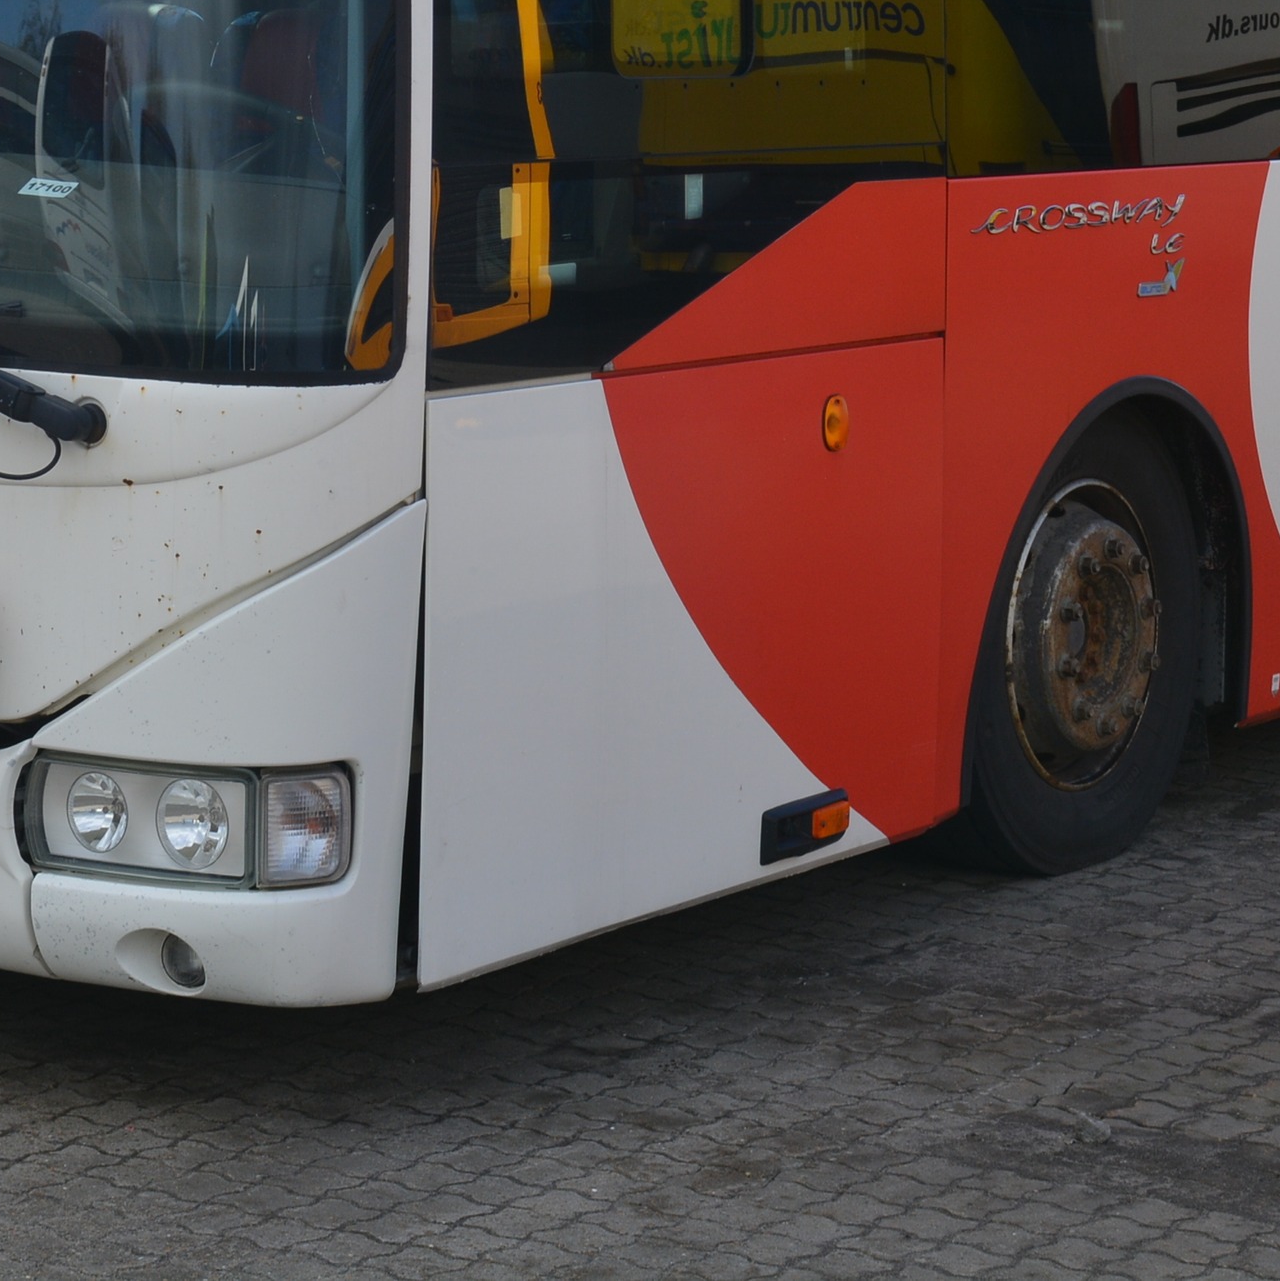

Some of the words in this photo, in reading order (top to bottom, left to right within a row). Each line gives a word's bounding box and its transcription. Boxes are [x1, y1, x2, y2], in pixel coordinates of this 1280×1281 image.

[27, 181, 73, 194] 17100
[971, 193, 1186, 235] CROSSWAY
[1150, 232, 1186, 255] LE
